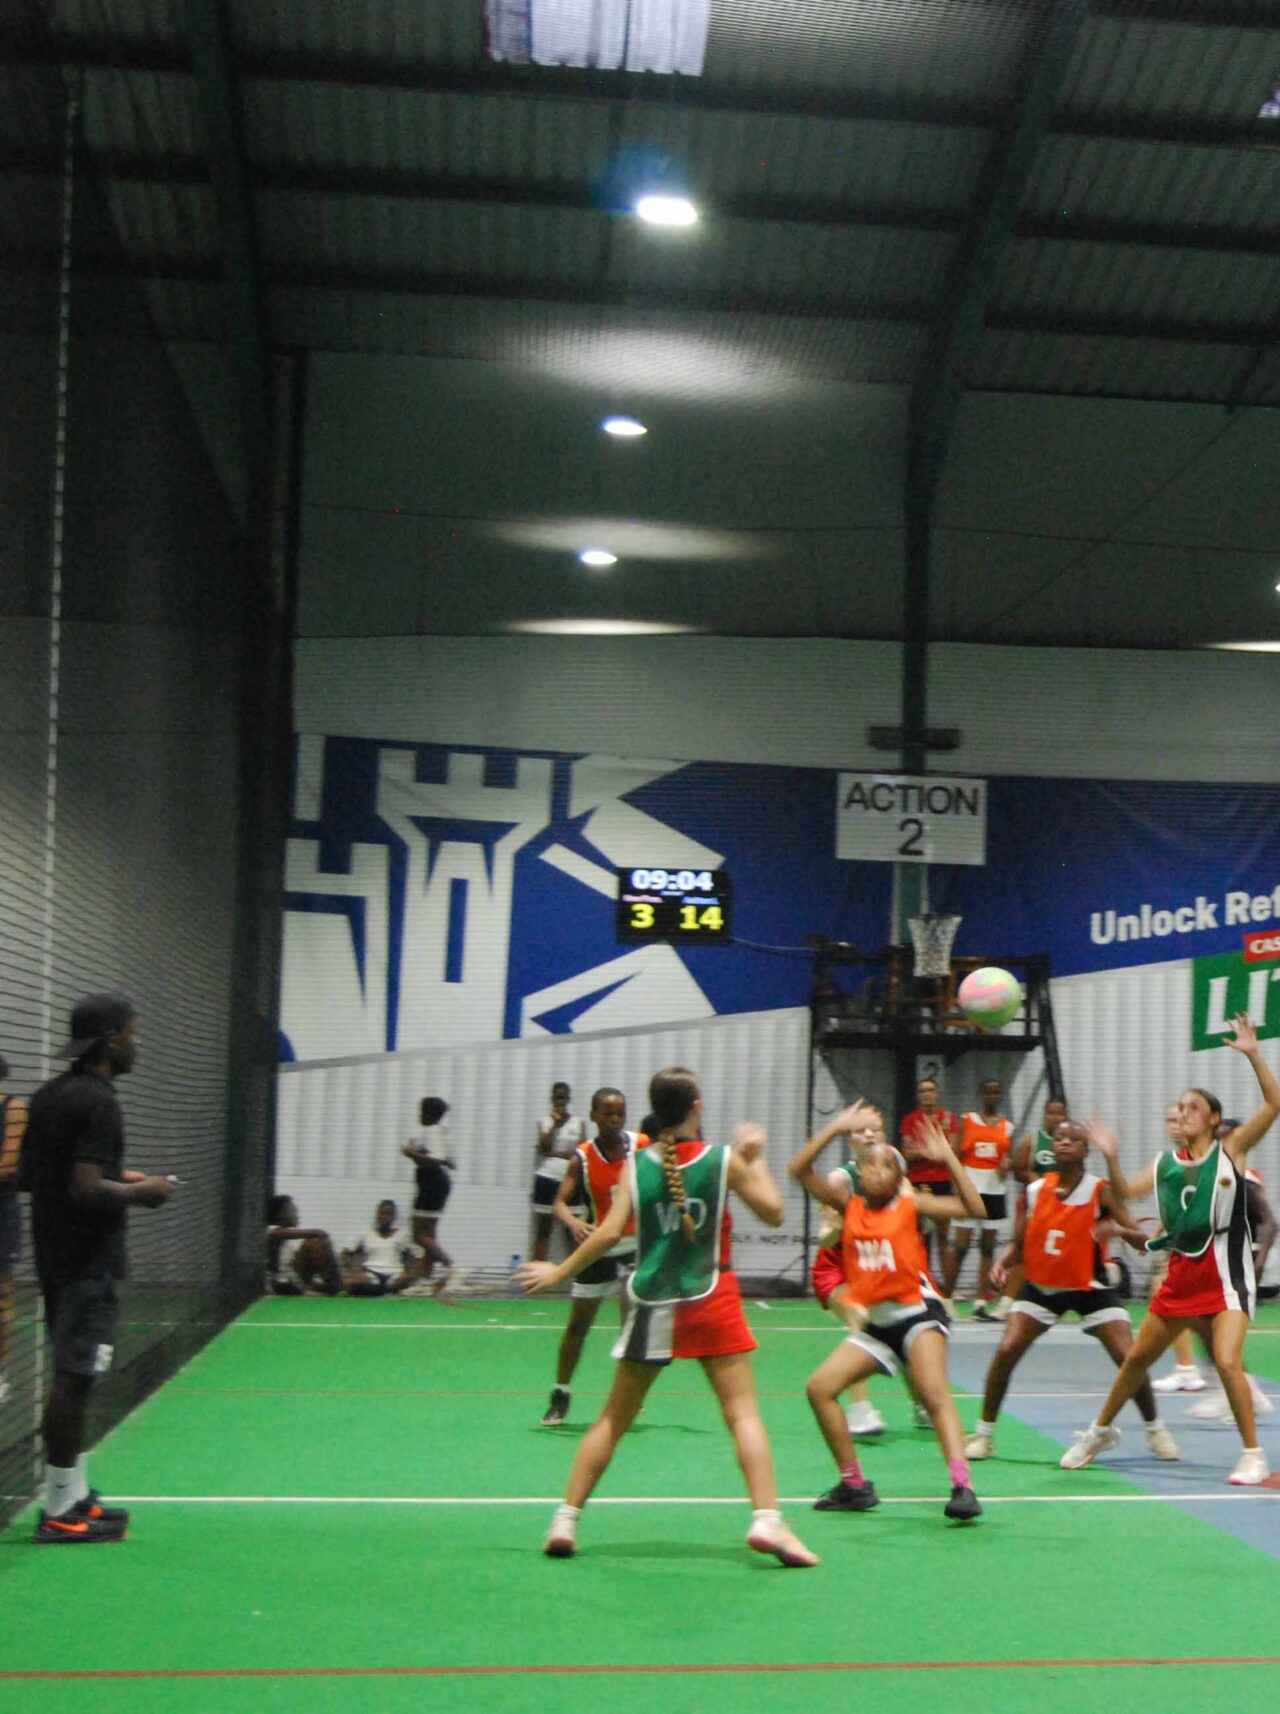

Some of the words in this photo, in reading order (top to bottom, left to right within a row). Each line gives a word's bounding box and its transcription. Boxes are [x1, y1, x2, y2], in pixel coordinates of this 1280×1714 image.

[844, 782, 980, 816] ACTION
[899, 818, 924, 856] 2
[631, 869, 714, 891] 09:04
[630, 903, 655, 929] 3
[680, 905, 724, 930] 14
[1090, 896, 1219, 945] Unlock
[855, 1238, 897, 1272] WA
